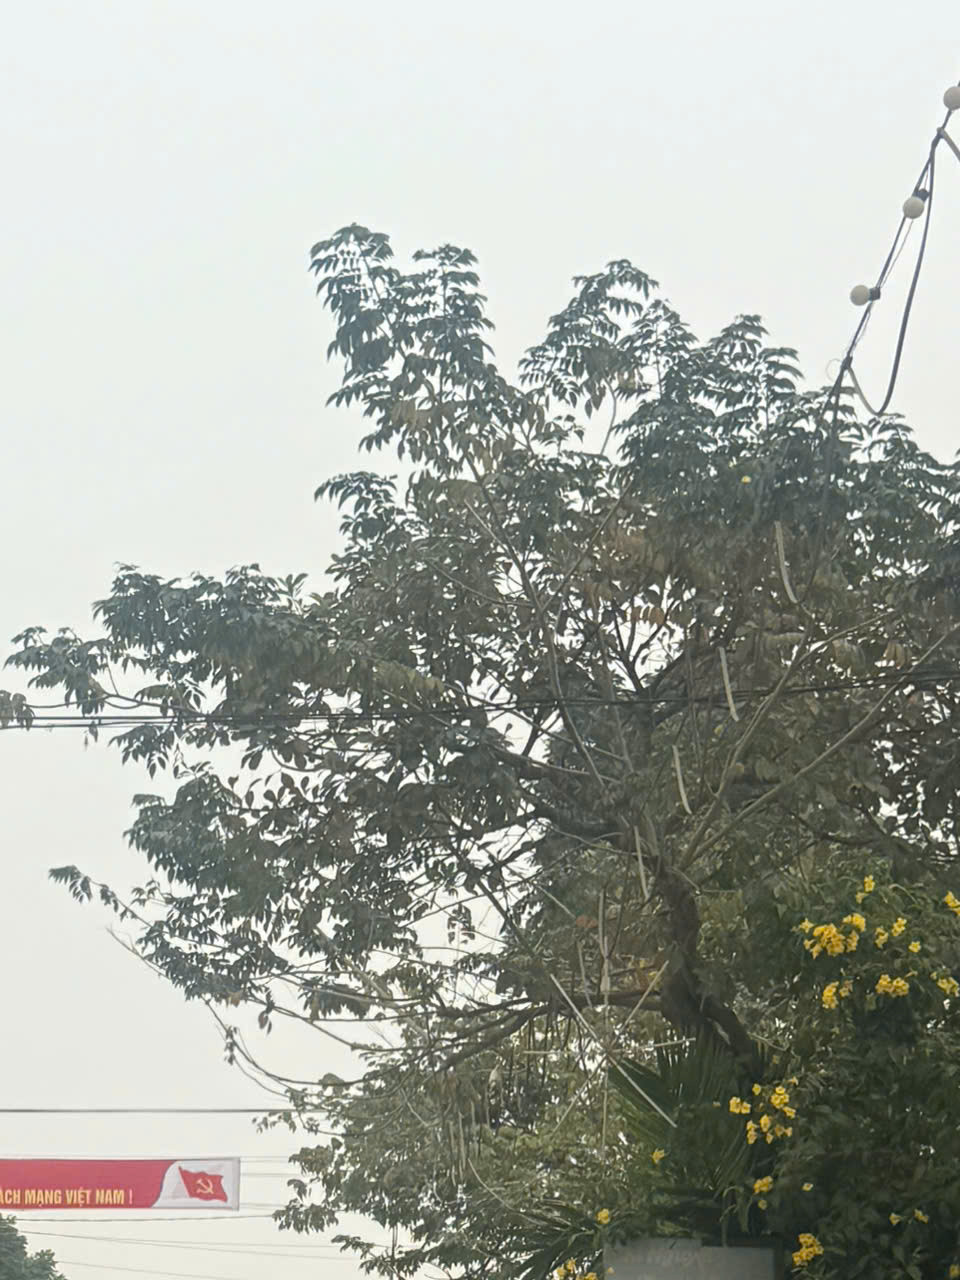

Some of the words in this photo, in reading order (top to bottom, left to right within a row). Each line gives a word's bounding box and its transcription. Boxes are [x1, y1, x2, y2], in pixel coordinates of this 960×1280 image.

[24, 1189, 63, 1207] MẠNG
[65, 1186, 93, 1207] VIỆT
[96, 1189, 125, 1205] NAM
